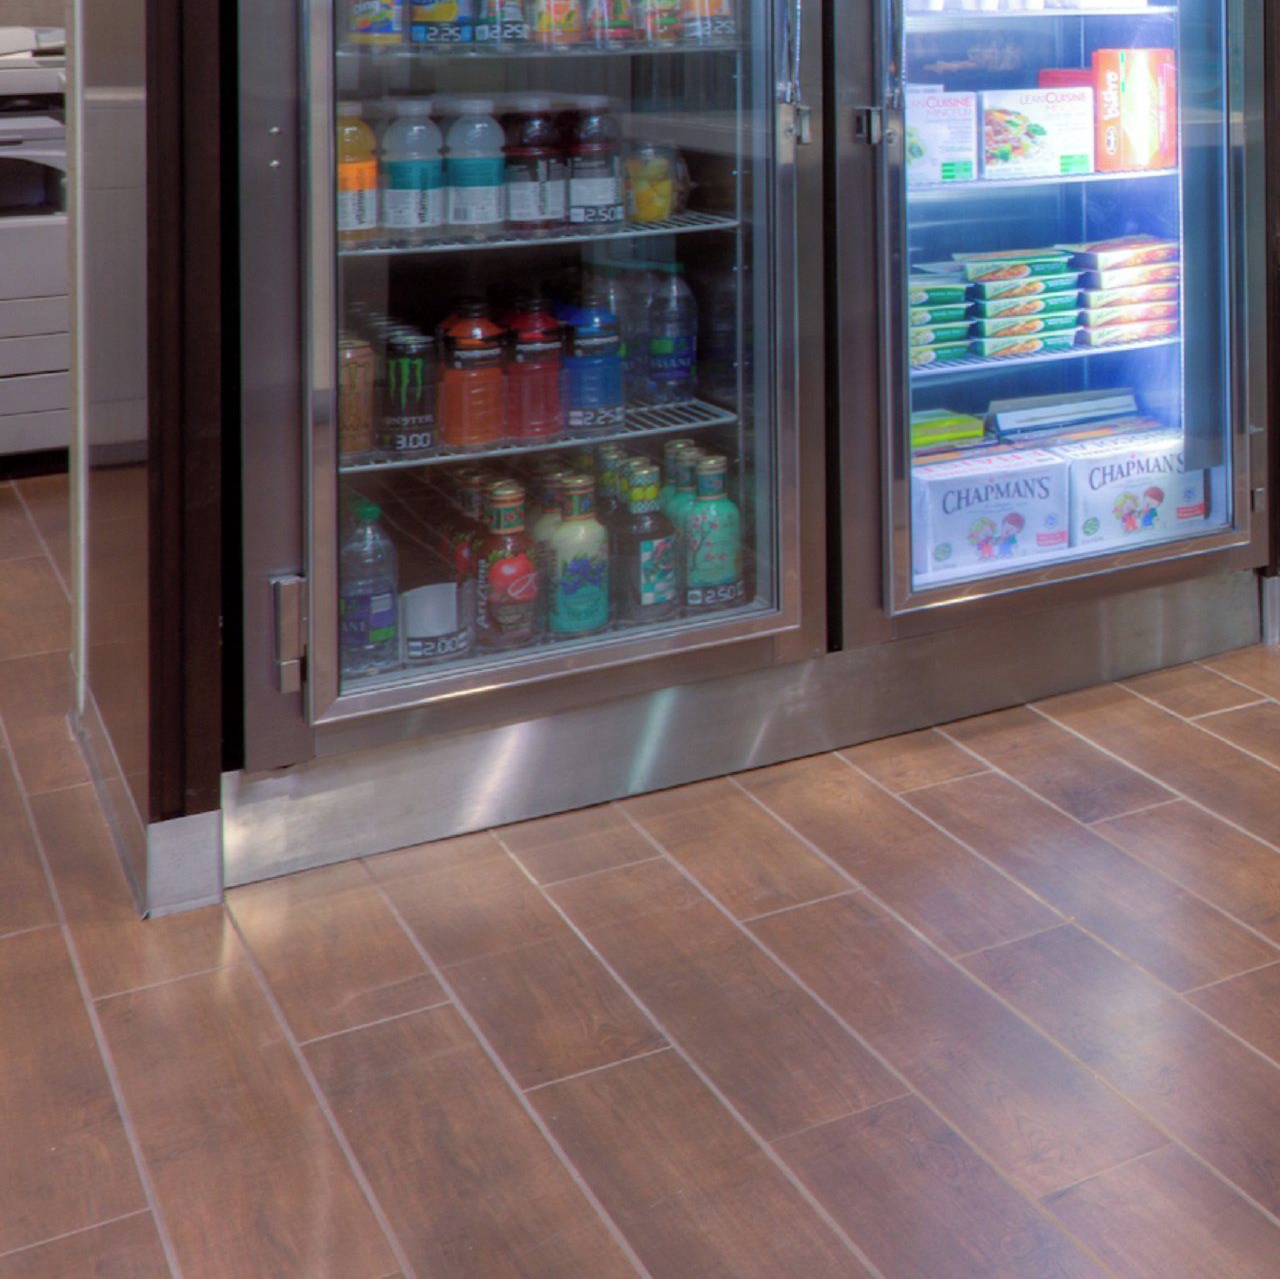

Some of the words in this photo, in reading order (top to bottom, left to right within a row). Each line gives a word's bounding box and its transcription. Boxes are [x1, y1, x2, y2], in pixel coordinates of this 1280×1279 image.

[426, 26, 462, 42] 2.25
[926, 95, 971, 109] CUISINE
[395, 432, 431, 451] 3.00
[1088, 452, 1185, 491] CHAPMAN'S
[942, 476, 1050, 515] CHAPMAN'S
[704, 584, 737, 604] 2.50
[423, 635, 458, 656] 2.00
